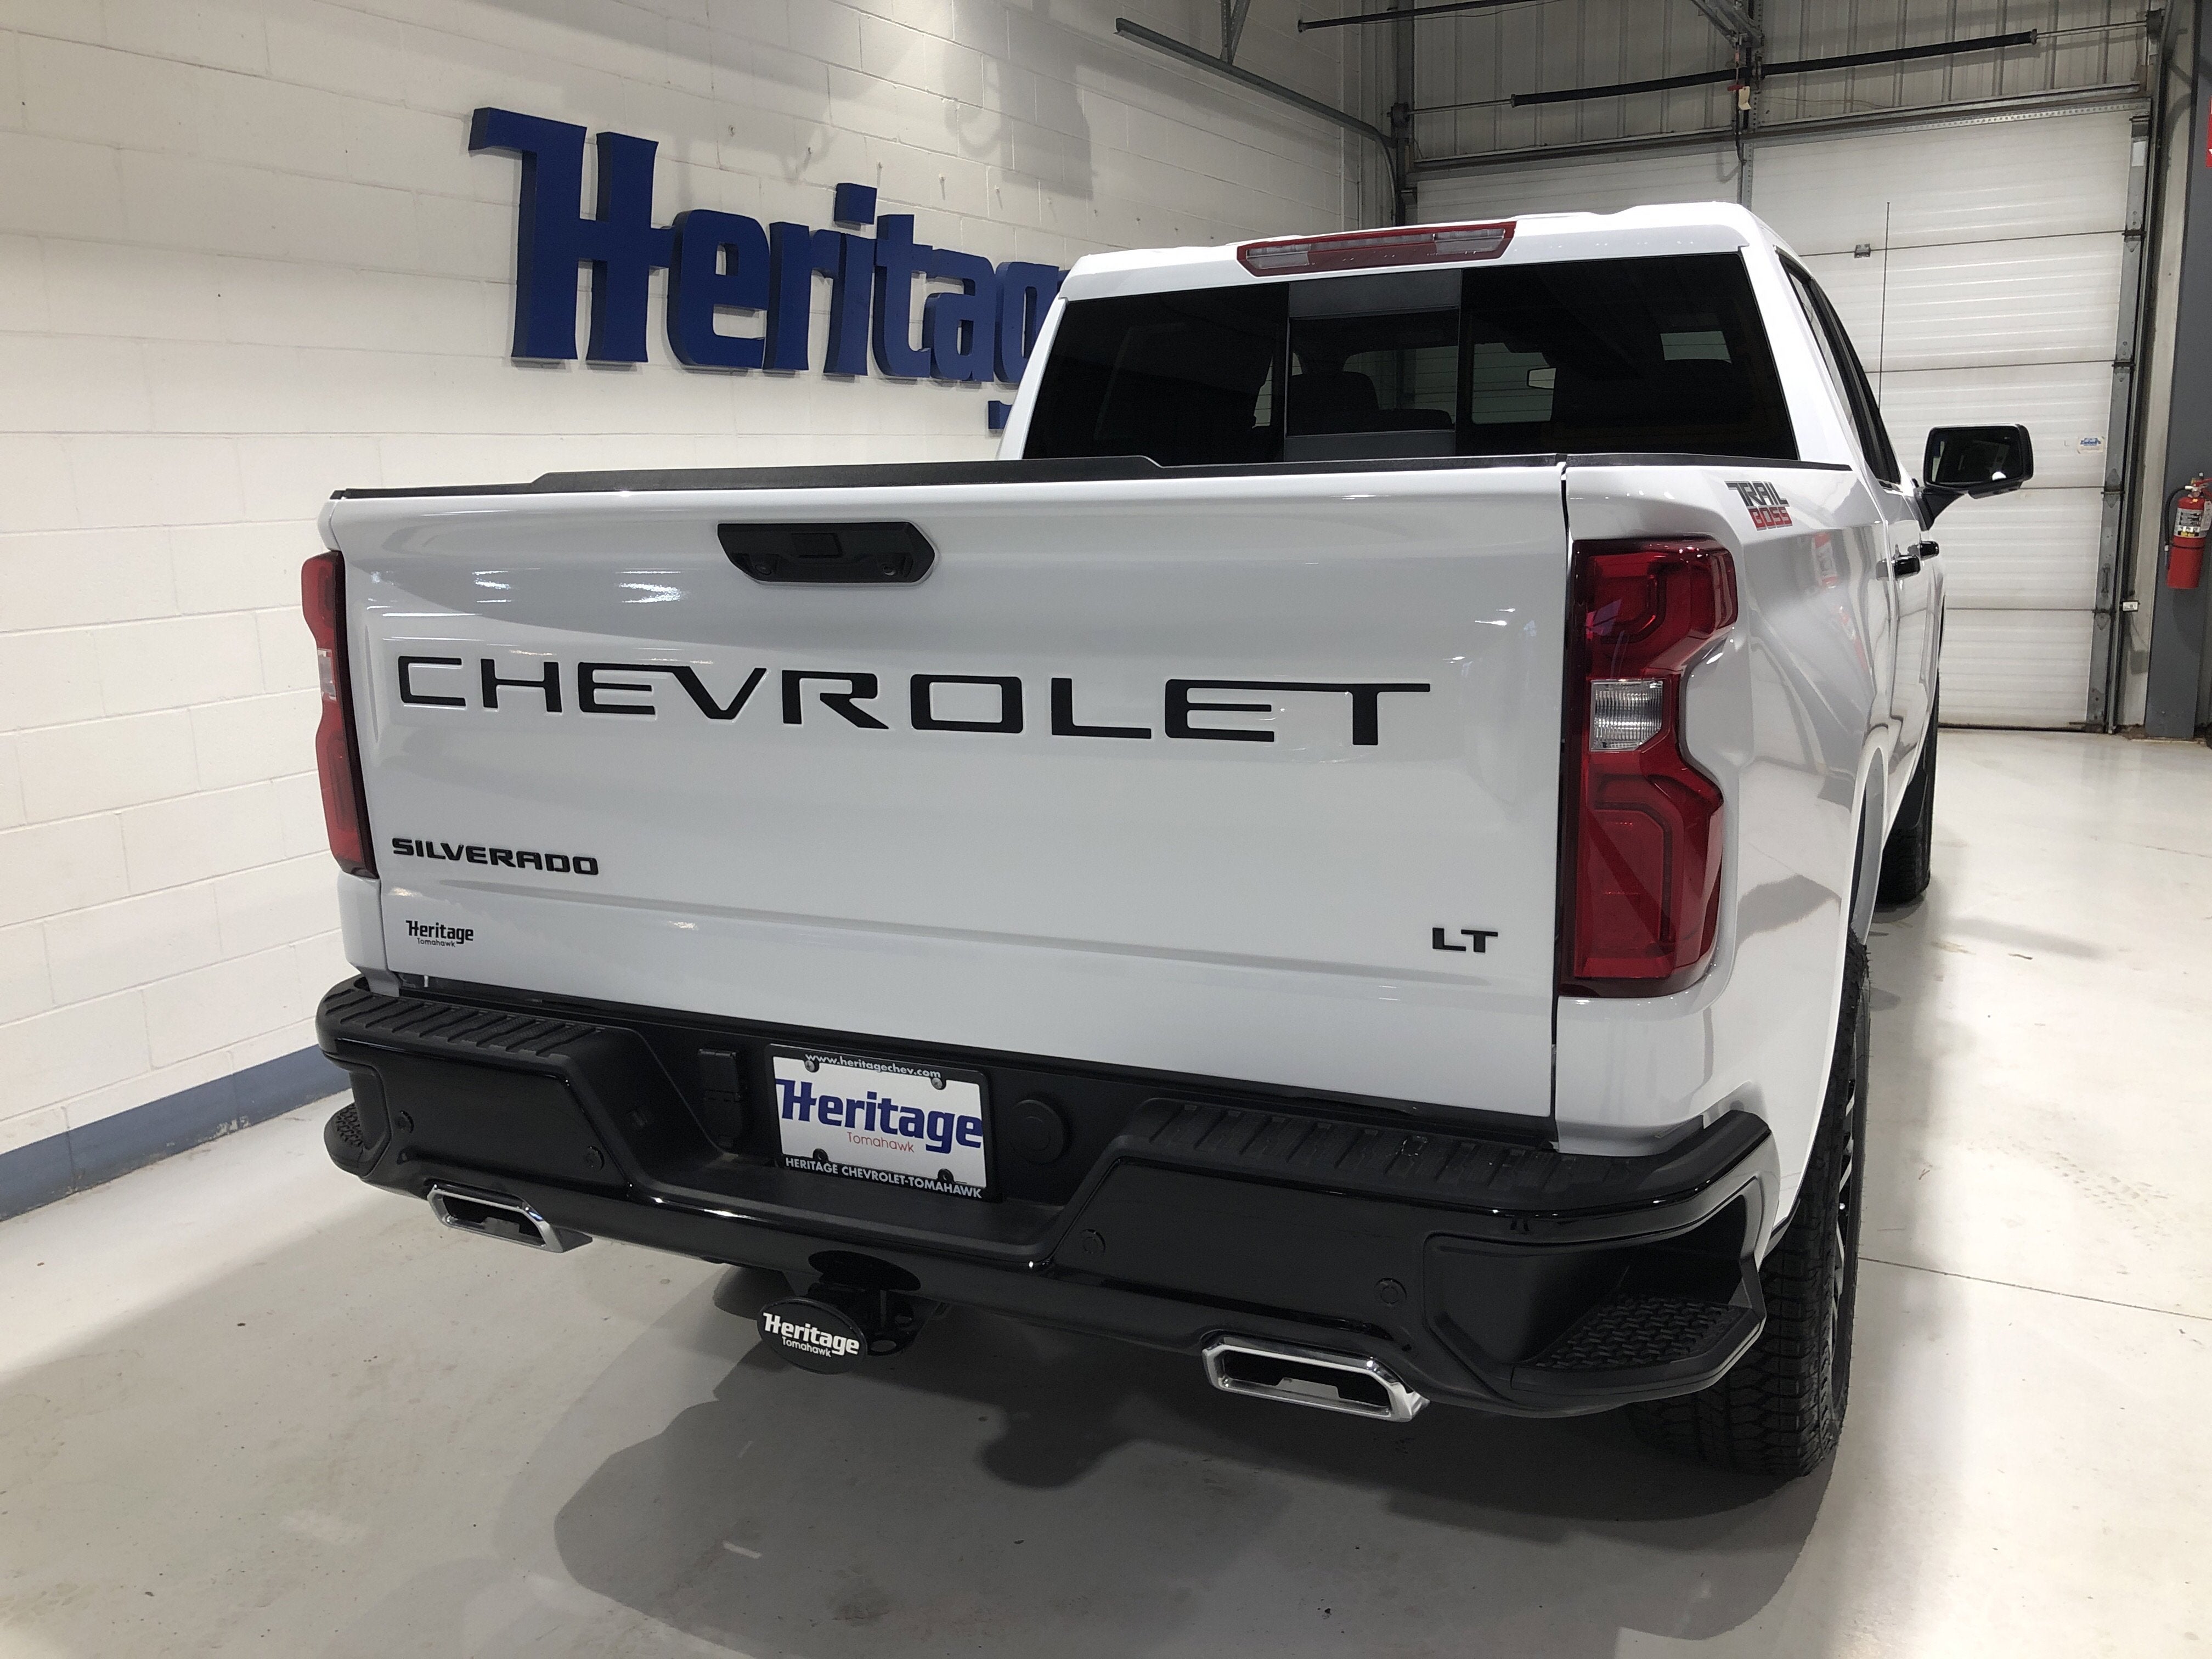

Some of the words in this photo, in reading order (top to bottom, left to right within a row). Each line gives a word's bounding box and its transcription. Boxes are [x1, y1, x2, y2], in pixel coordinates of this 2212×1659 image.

[468, 107, 1070, 430] Heritag
[1724, 481, 1790, 508] TRAIL
[1748, 506, 1792, 531] BOSS
[398, 656, 1430, 746] CHEVROLET
[392, 837, 599, 876] SILVERADO
[406, 920, 474, 944] Heritage
[417, 938, 456, 947] Tomahawk
[1432, 927, 1498, 953] LT
[805, 1053, 941, 1079] www.heritagechev.com
[775, 1078, 983, 1154] Heritage
[847, 1131, 915, 1153] Tomahawk
[786, 1157, 839, 1175] HERITAGE
[763, 1312, 860, 1356] Heritage
[782, 1336, 832, 1358] Tomahawk
